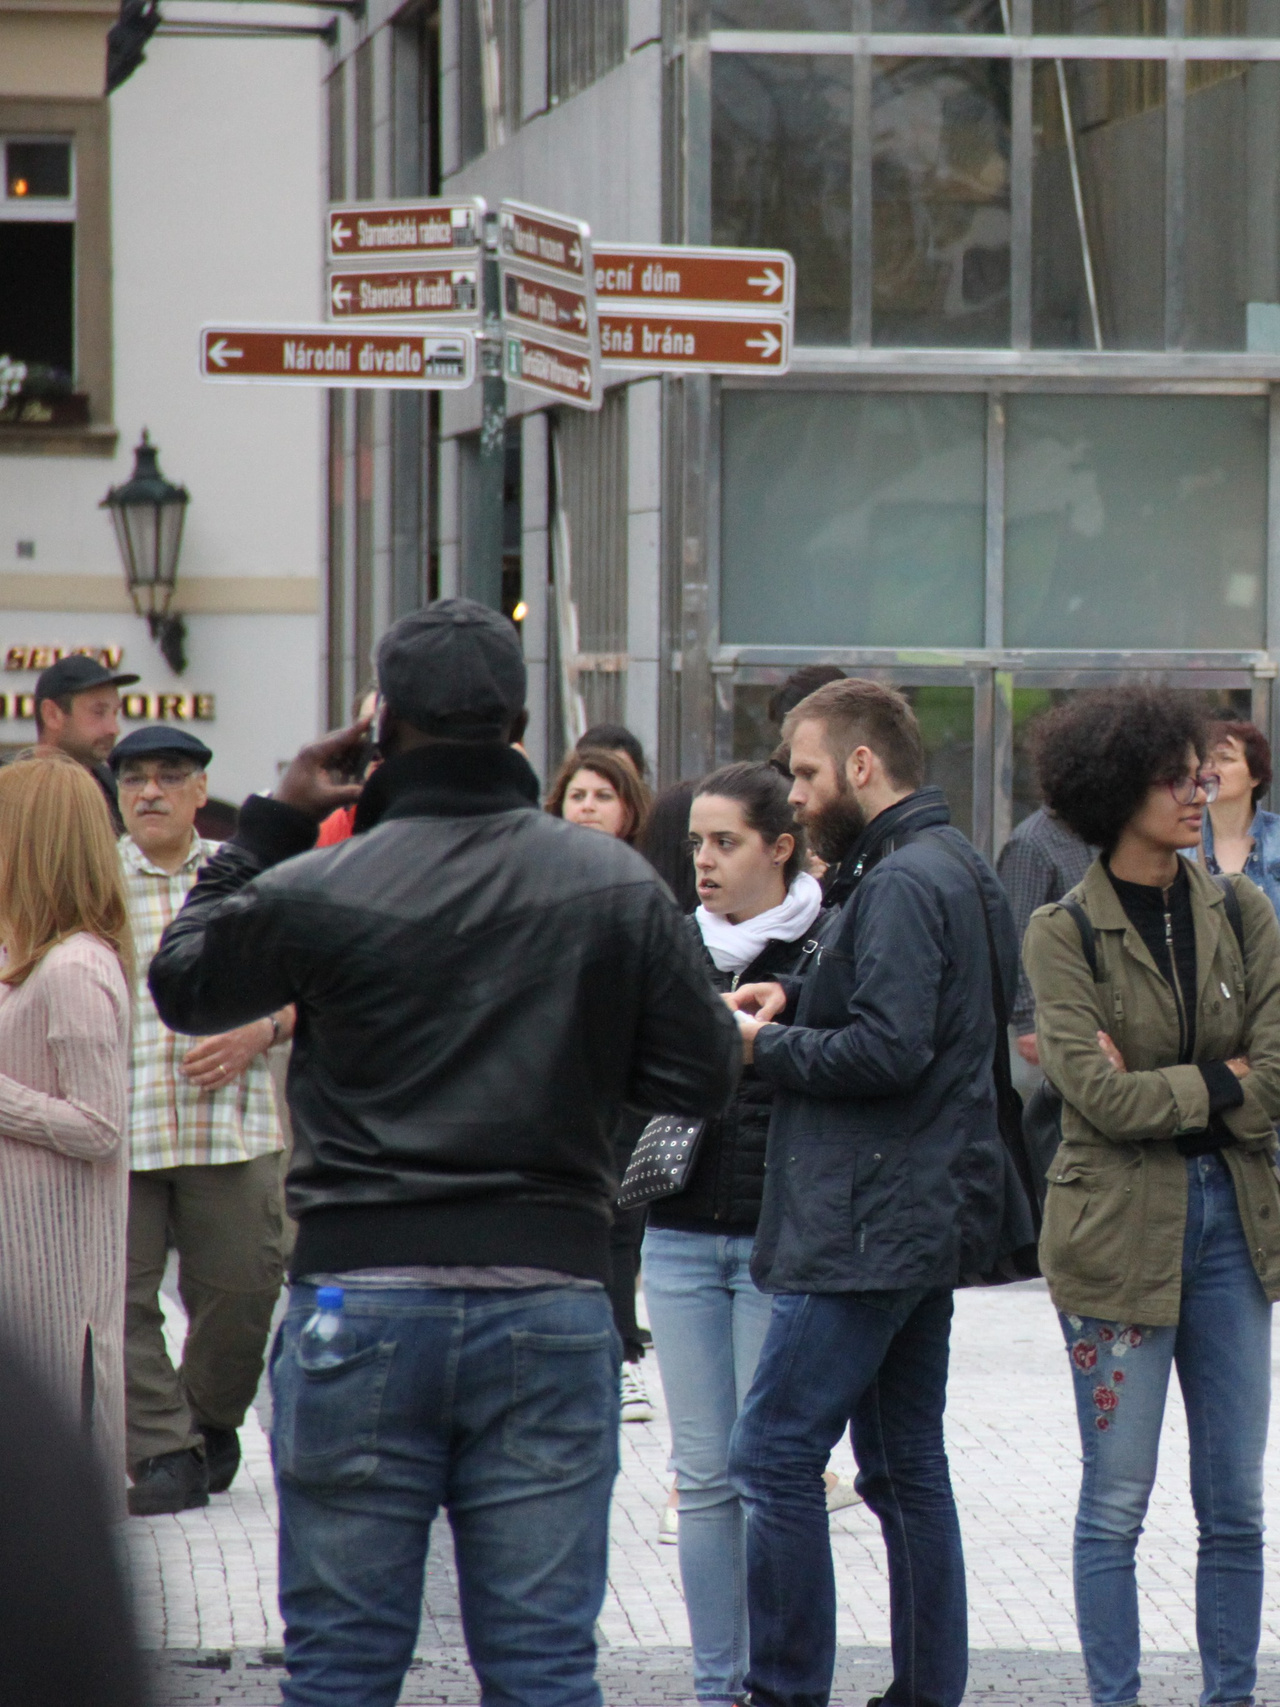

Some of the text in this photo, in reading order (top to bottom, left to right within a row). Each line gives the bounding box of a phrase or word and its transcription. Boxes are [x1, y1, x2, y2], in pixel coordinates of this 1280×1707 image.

[594, 261, 681, 293] ecní dům
[601, 323, 696, 355] šná brána
[282, 339, 422, 373] Národní divadlo
[121, 693, 216, 719] ORE
